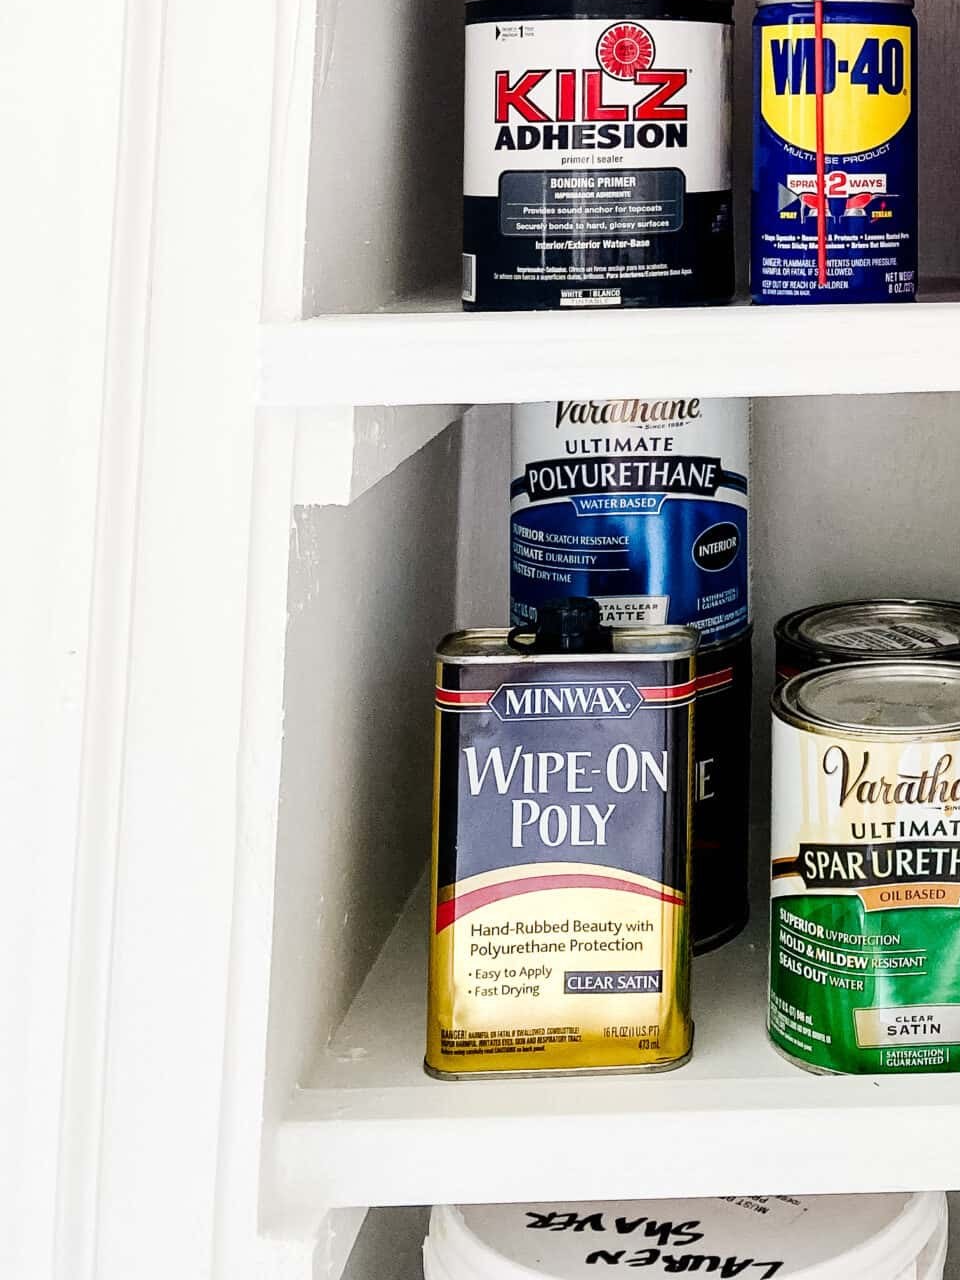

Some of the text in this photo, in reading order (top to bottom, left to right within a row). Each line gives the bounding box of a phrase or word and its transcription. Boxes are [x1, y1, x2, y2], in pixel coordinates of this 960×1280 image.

[770, 38, 904, 95] WD-40
[494, 69, 689, 123] KILZ
[494, 123, 689, 151] ADHESION
[561, 155, 623, 165] primer sealer
[783, 143, 890, 164] MULTI-SE PRODUCT
[550, 177, 636, 189] BONDING PRIMER
[828, 173, 847, 195] 2
[850, 180, 882, 188] WAYS
[523, 206, 556, 215] Provides
[557, 206, 583, 214] sound
[629, 205, 662, 215] topcoats
[586, 221, 608, 231] hard,
[610, 221, 635, 231] glossy
[637, 220, 669, 228] surfaces
[535, 239, 650, 250] Interior/Exterior Water-Base
[561, 289, 621, 298] WHITE BLANCO
[556, 398, 701, 429] Varathane
[565, 437, 673, 454] ULTIMATE
[529, 462, 717, 493] POLYURETHANE
[580, 499, 656, 510] WATER BASED
[546, 534, 578, 544] SCRATCH
[580, 536, 629, 545] RESISTANCE
[699, 537, 737, 557] INTERIOR
[546, 553, 597, 564] DURABILITY
[536, 570, 551, 580] DRY
[553, 572, 572, 583] TIME
[505, 687, 627, 716] MINWAX
[462, 743, 668, 796] WIPE-ON
[512, 799, 616, 848] POLY
[805, 850, 866, 880] SPAR
[879, 888, 946, 902] OIL BASED
[470, 921, 654, 937] Hand-Rubbed Beauty with
[779, 907, 900, 945] SUPERIOR UV PROTECTION
[470, 938, 643, 958] Polyurethane Protection
[779, 930, 806, 954] MOLD
[815, 948, 869, 969] MILDEW
[871, 957, 925, 969] RESISTANT
[475, 966, 552, 981] Easy to Apply
[779, 951, 864, 992] SEALS OUT WATER
[567, 975, 659, 990] CLEAR SATIN
[475, 985, 540, 998] Fast Drying
[888, 1025, 941, 1036] SATIN
[886, 1049, 944, 1058] SATISFACTION
[886, 1056, 944, 1066] GUARANTEED
[525, 1210, 705, 1246] SHAVER
[584, 1249, 785, 1280] LAUREN
